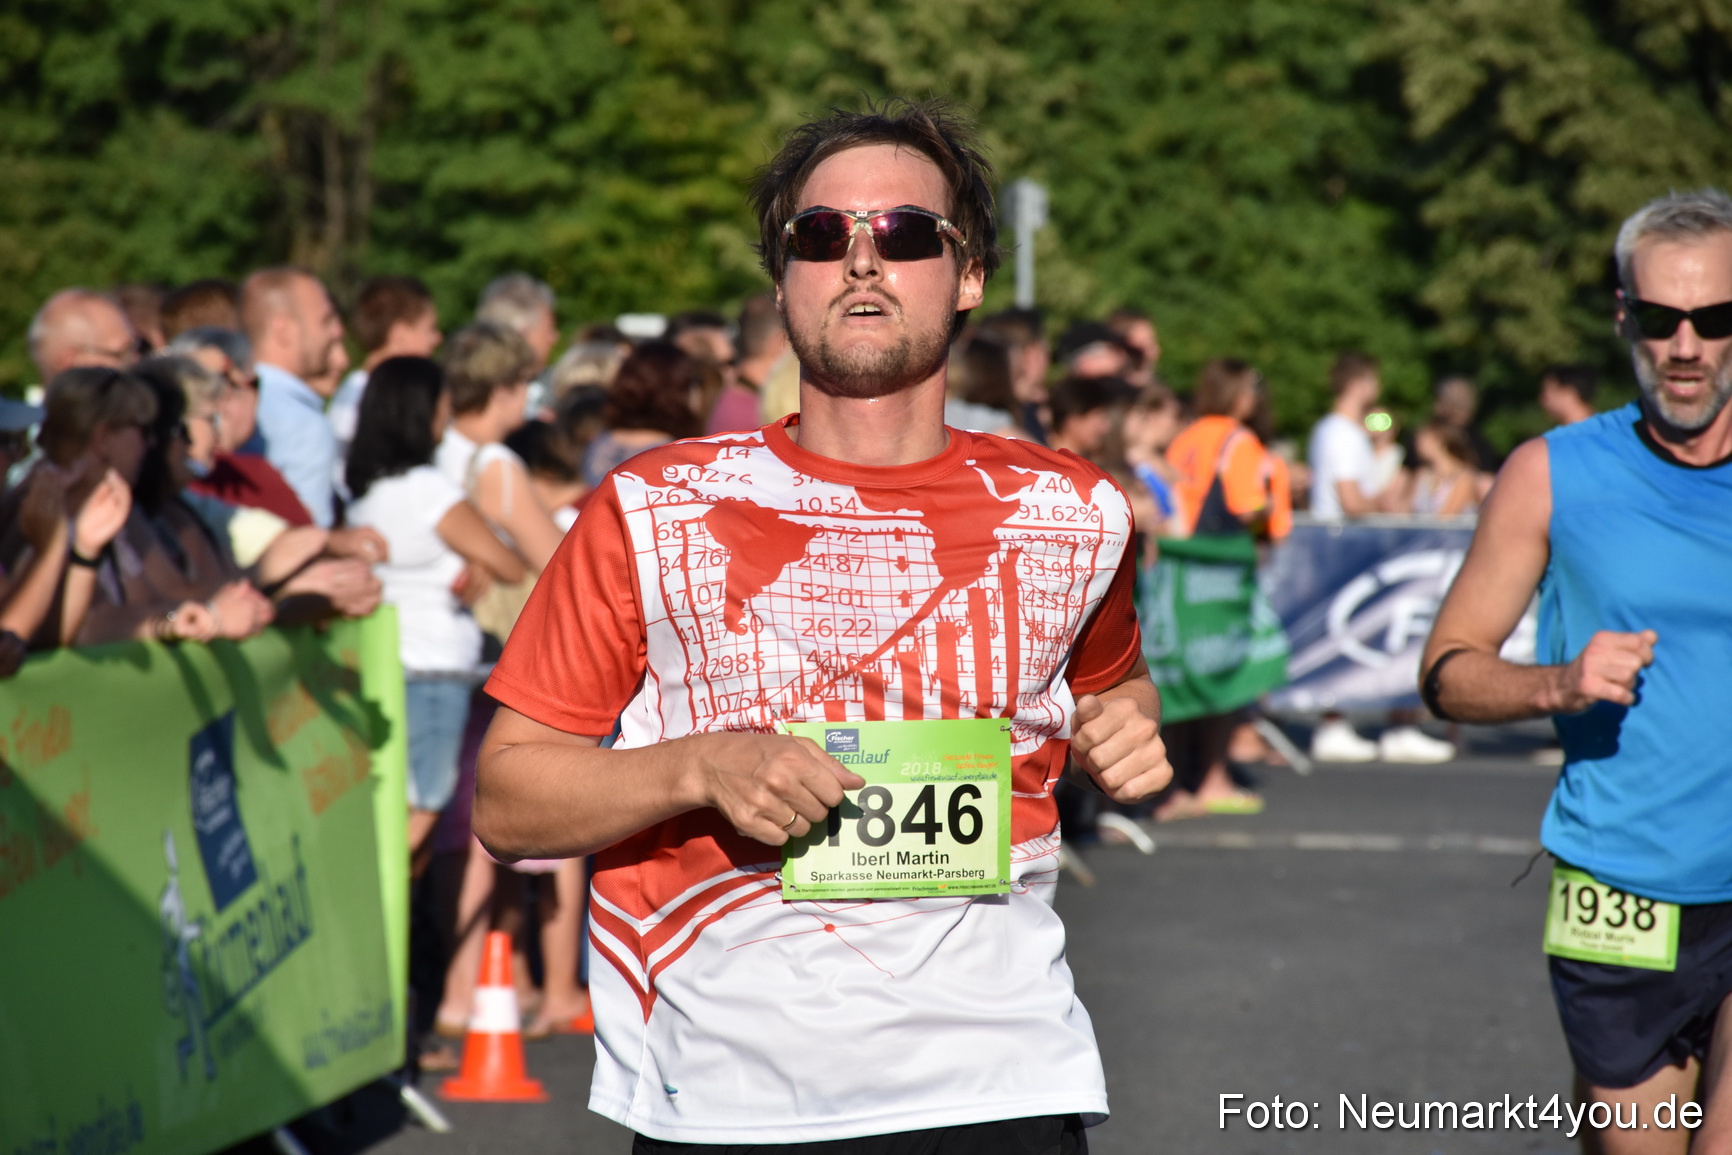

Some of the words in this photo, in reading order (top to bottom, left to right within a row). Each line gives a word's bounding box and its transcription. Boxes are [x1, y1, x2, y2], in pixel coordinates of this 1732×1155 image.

[663, 465, 753, 485] 90276
[794, 496, 859, 514] 10.54
[1018, 503, 1100, 523] 91.62%
[798, 553, 865, 574] 24.87
[800, 583, 868, 609] 52.01
[801, 617, 872, 638] 26.22
[901, 761, 942, 776] 2018
[828, 783, 983, 847] 1846
[852, 852, 889, 866] Iberl
[896, 851, 950, 865] Martin
[811, 870, 873, 883] Sparkasse
[876, 868, 985, 880] Neumarkt-Parsberg
[1560, 882, 1656, 932] 1938
